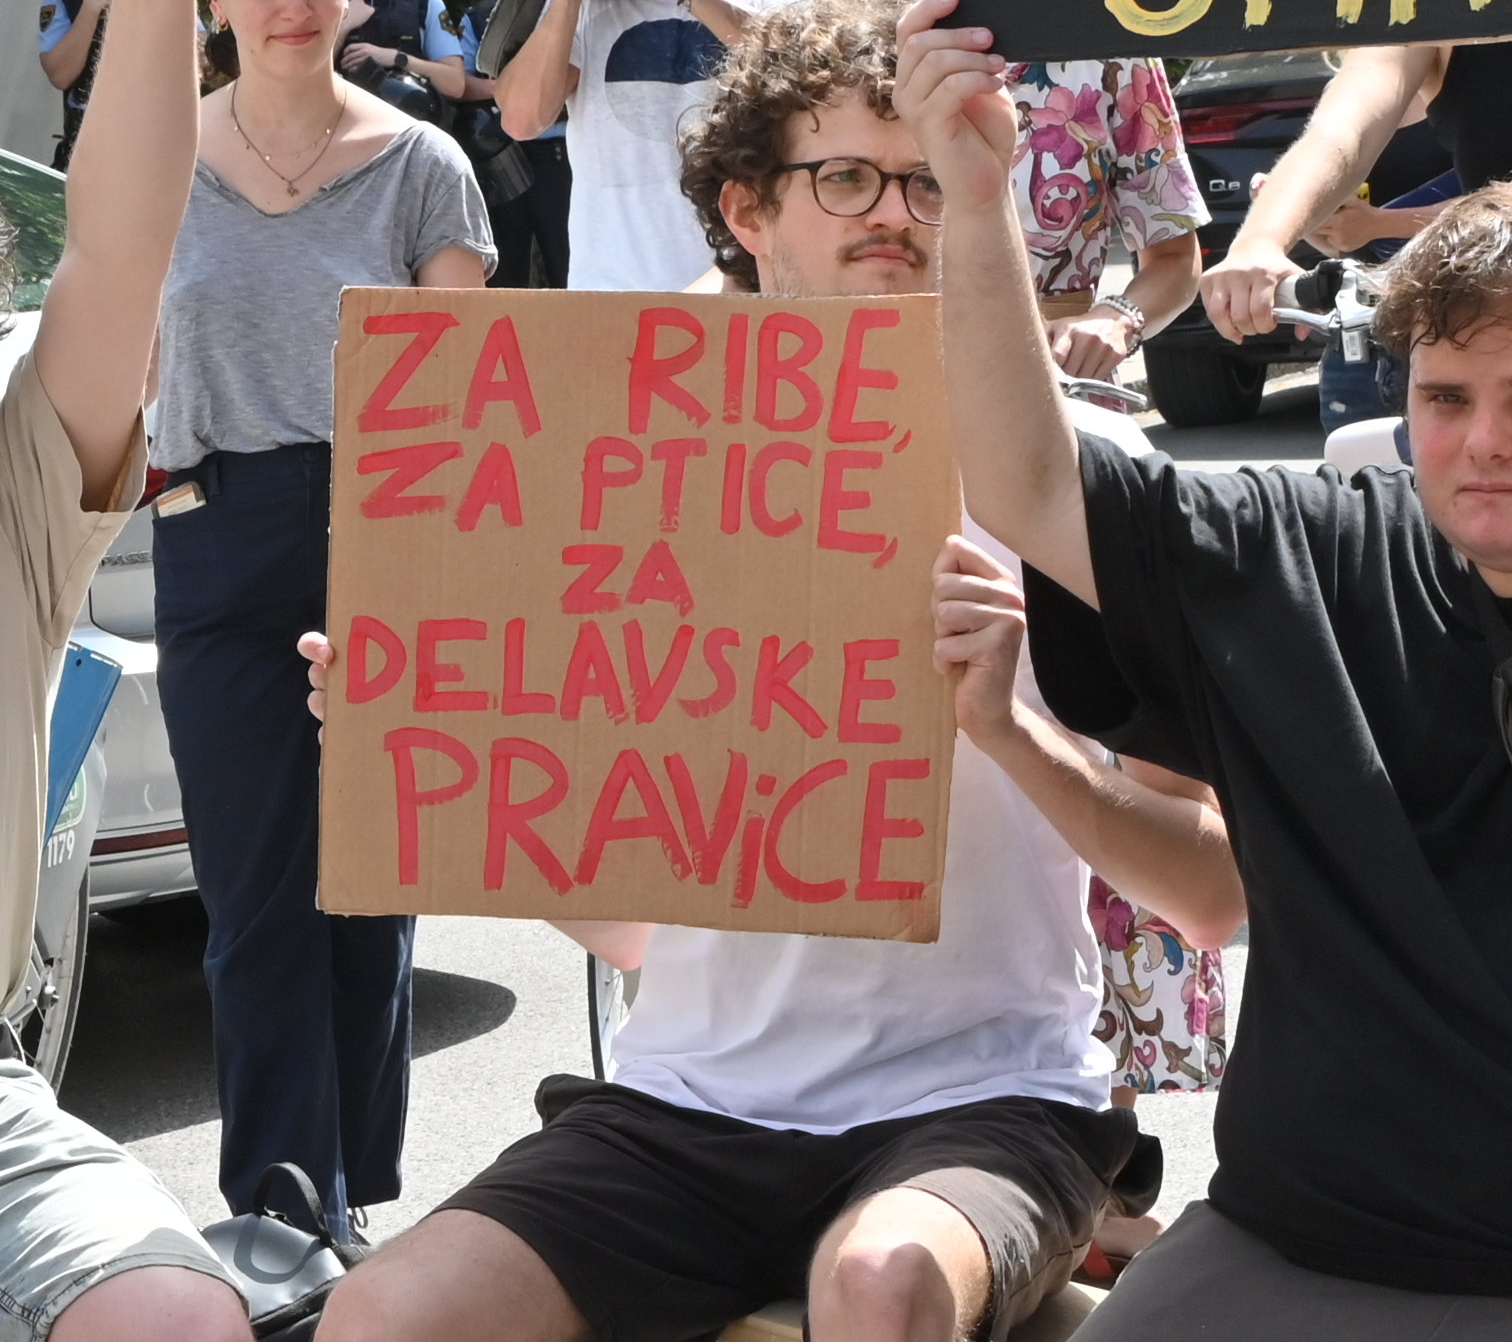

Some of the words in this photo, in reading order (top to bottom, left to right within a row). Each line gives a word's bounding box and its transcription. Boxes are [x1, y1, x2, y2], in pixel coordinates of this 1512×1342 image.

[357, 311, 541, 438] ZA
[626, 307, 911, 454] RIBE,
[357, 440, 524, 532] ZA
[580, 436, 898, 569] PTICE,
[561, 539, 695, 617] ZA
[345, 615, 902, 745] DELAVSKE
